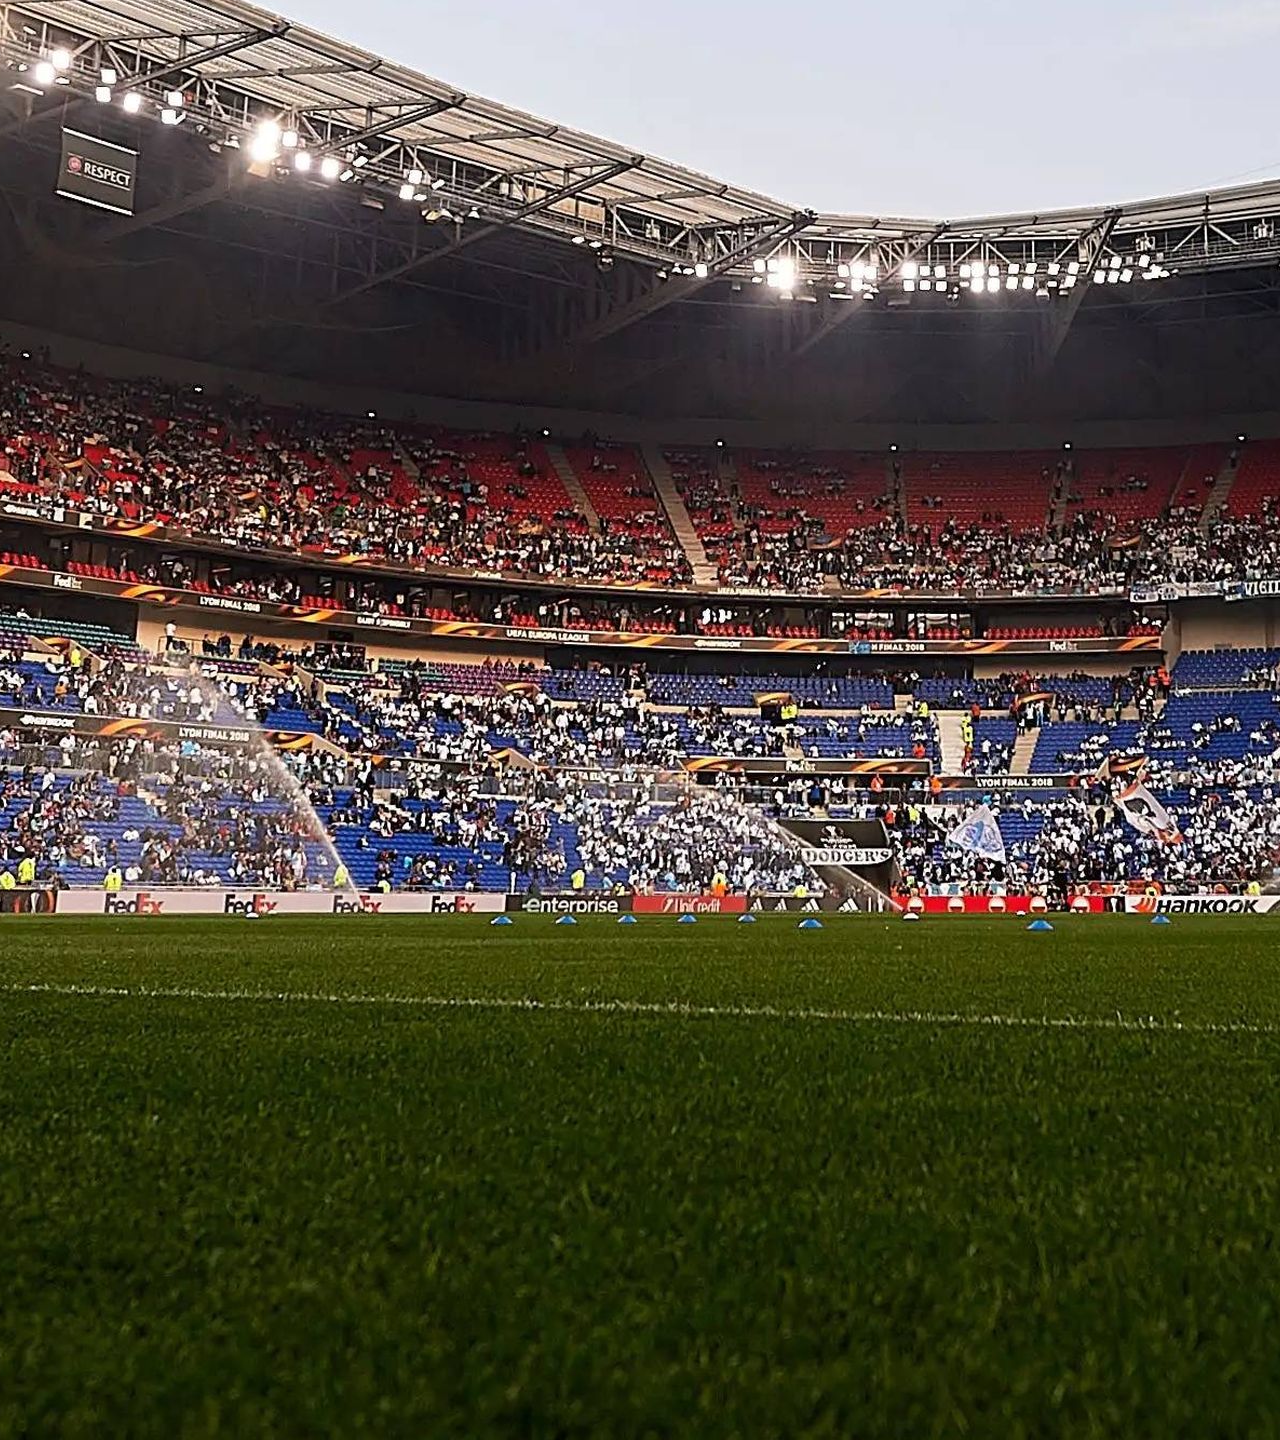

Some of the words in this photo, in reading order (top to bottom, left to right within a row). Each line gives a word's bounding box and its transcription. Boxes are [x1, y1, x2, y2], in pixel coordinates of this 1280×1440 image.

[84, 162, 131, 187] RESPECT
[199, 596, 221, 606] LYON
[879, 643, 903, 651] FINAL
[905, 643, 925, 651] 2018
[179, 727, 202, 738] LYON
[202, 729, 228, 740] FINAL
[229, 730, 250, 742] 2018
[977, 778, 1001, 787] LYON
[1002, 778, 1030, 787] FINAL
[1031, 778, 1053, 787] 2018
[805, 850, 890, 863] DODGER'S
[104, 892, 165, 914] FedEx
[224, 893, 278, 915] FedEx
[333, 895, 382, 914] FedEx
[431, 895, 475, 913] FedEx
[522, 895, 619, 913] enterprise
[674, 897, 721, 913] UniCredit
